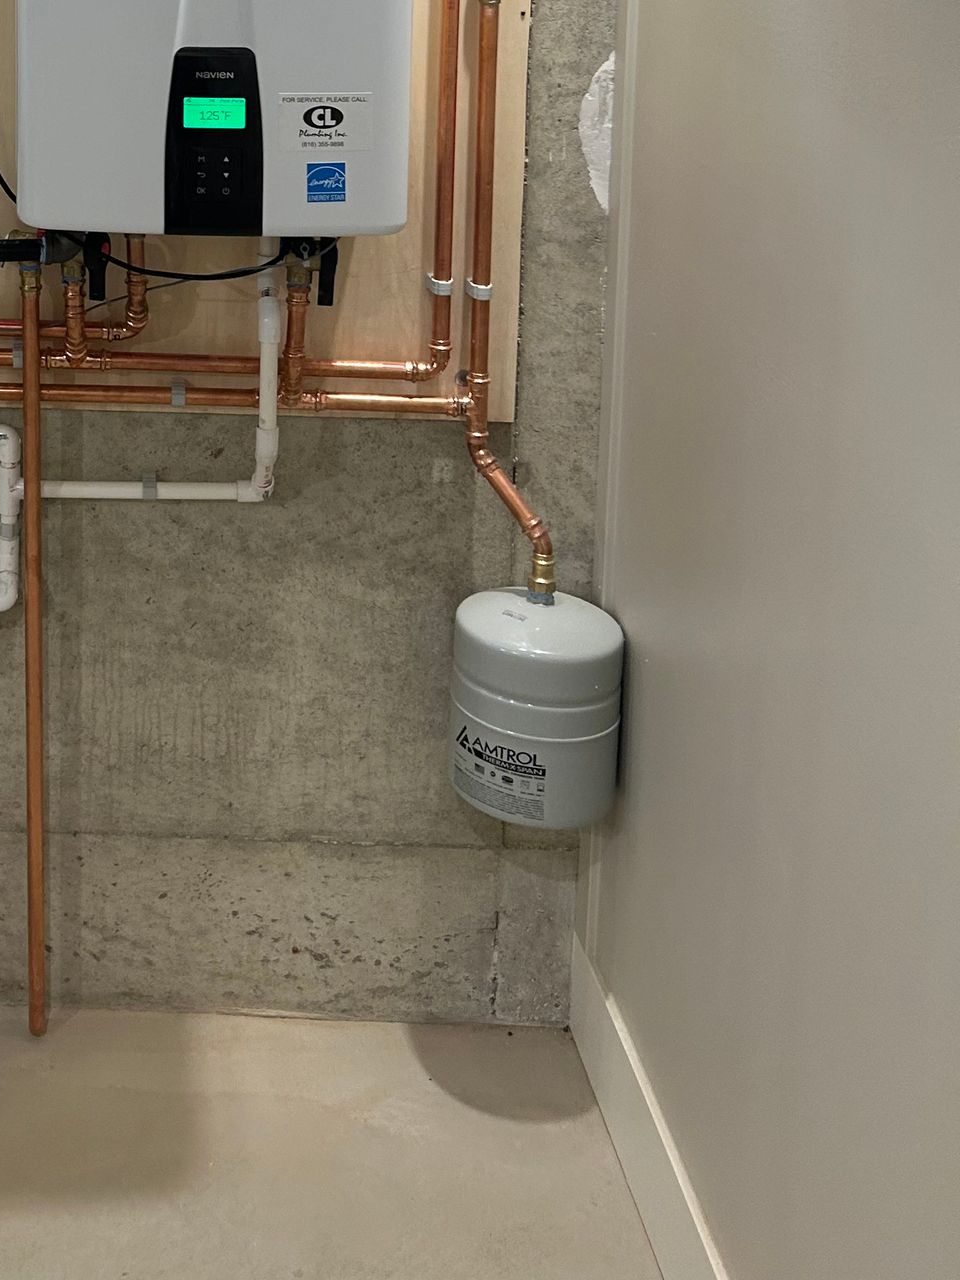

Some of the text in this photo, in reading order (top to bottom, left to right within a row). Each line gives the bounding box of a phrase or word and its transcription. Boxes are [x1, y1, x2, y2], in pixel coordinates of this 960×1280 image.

[311, 108, 337, 126] CL
[298, 129, 333, 140] Plumbing
[472, 737, 543, 767] AMTROL
